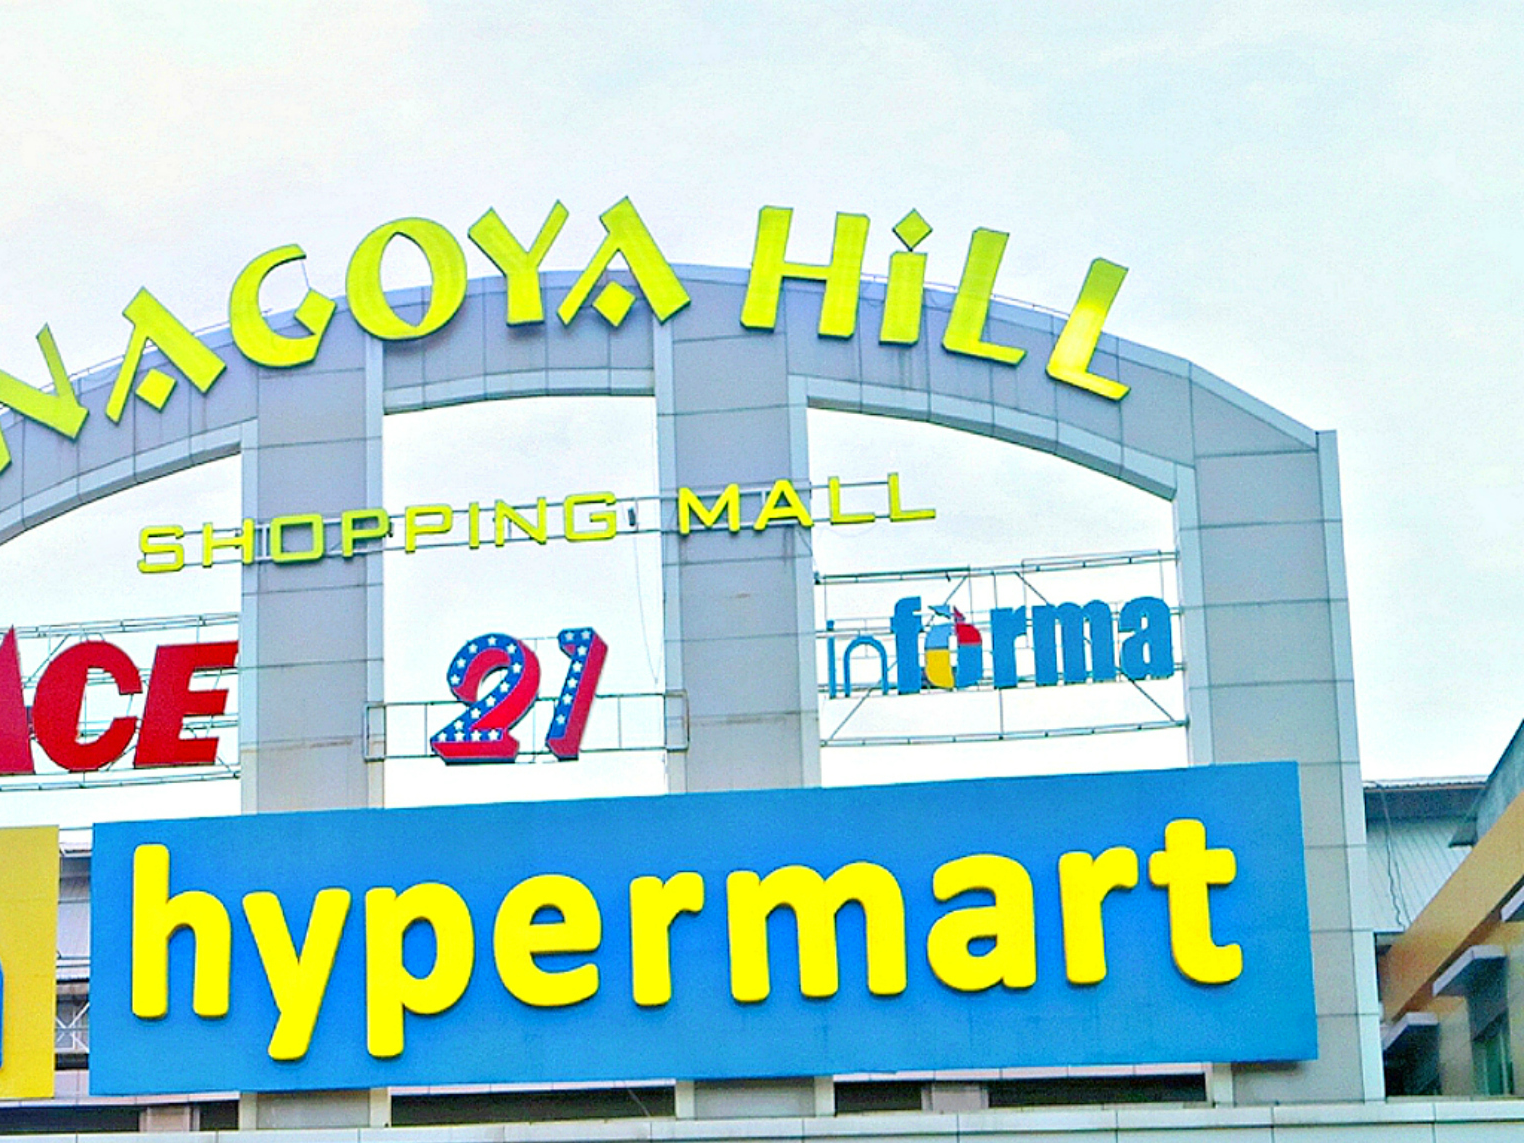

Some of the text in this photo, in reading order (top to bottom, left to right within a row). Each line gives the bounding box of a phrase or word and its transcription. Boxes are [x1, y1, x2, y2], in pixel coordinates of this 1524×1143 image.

[137, 472, 936, 574] SHOPPING MALL
[826, 596, 1175, 699] informa
[131, 818, 1244, 1062] hypermart
